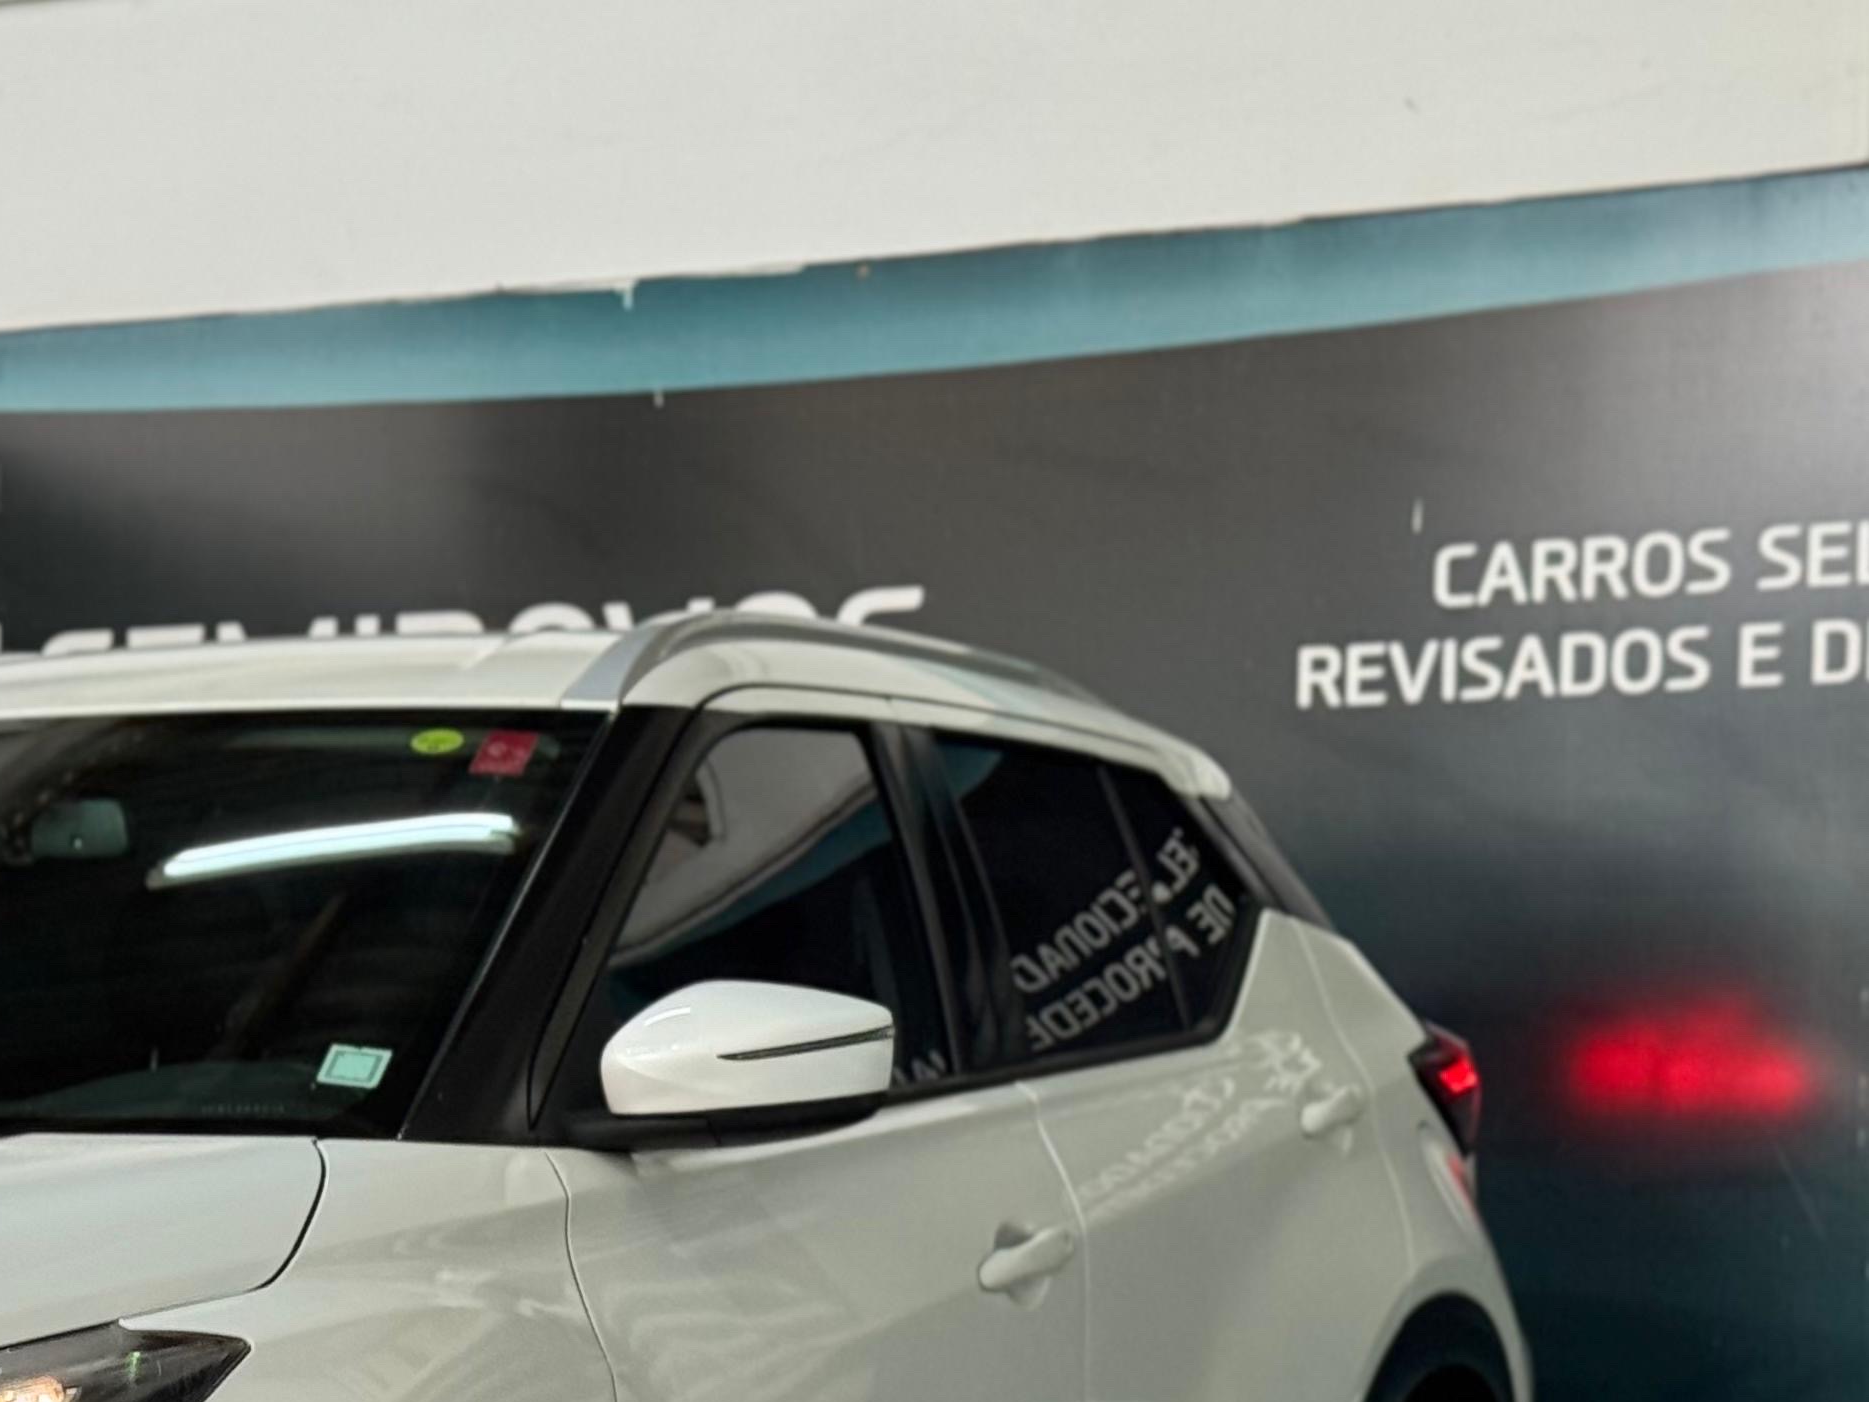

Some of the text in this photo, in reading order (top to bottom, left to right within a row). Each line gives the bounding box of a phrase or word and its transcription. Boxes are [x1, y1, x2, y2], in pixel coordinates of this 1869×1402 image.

[1433, 528, 1732, 609] CARROS
[1296, 618, 1869, 710] REVISADOS E D
